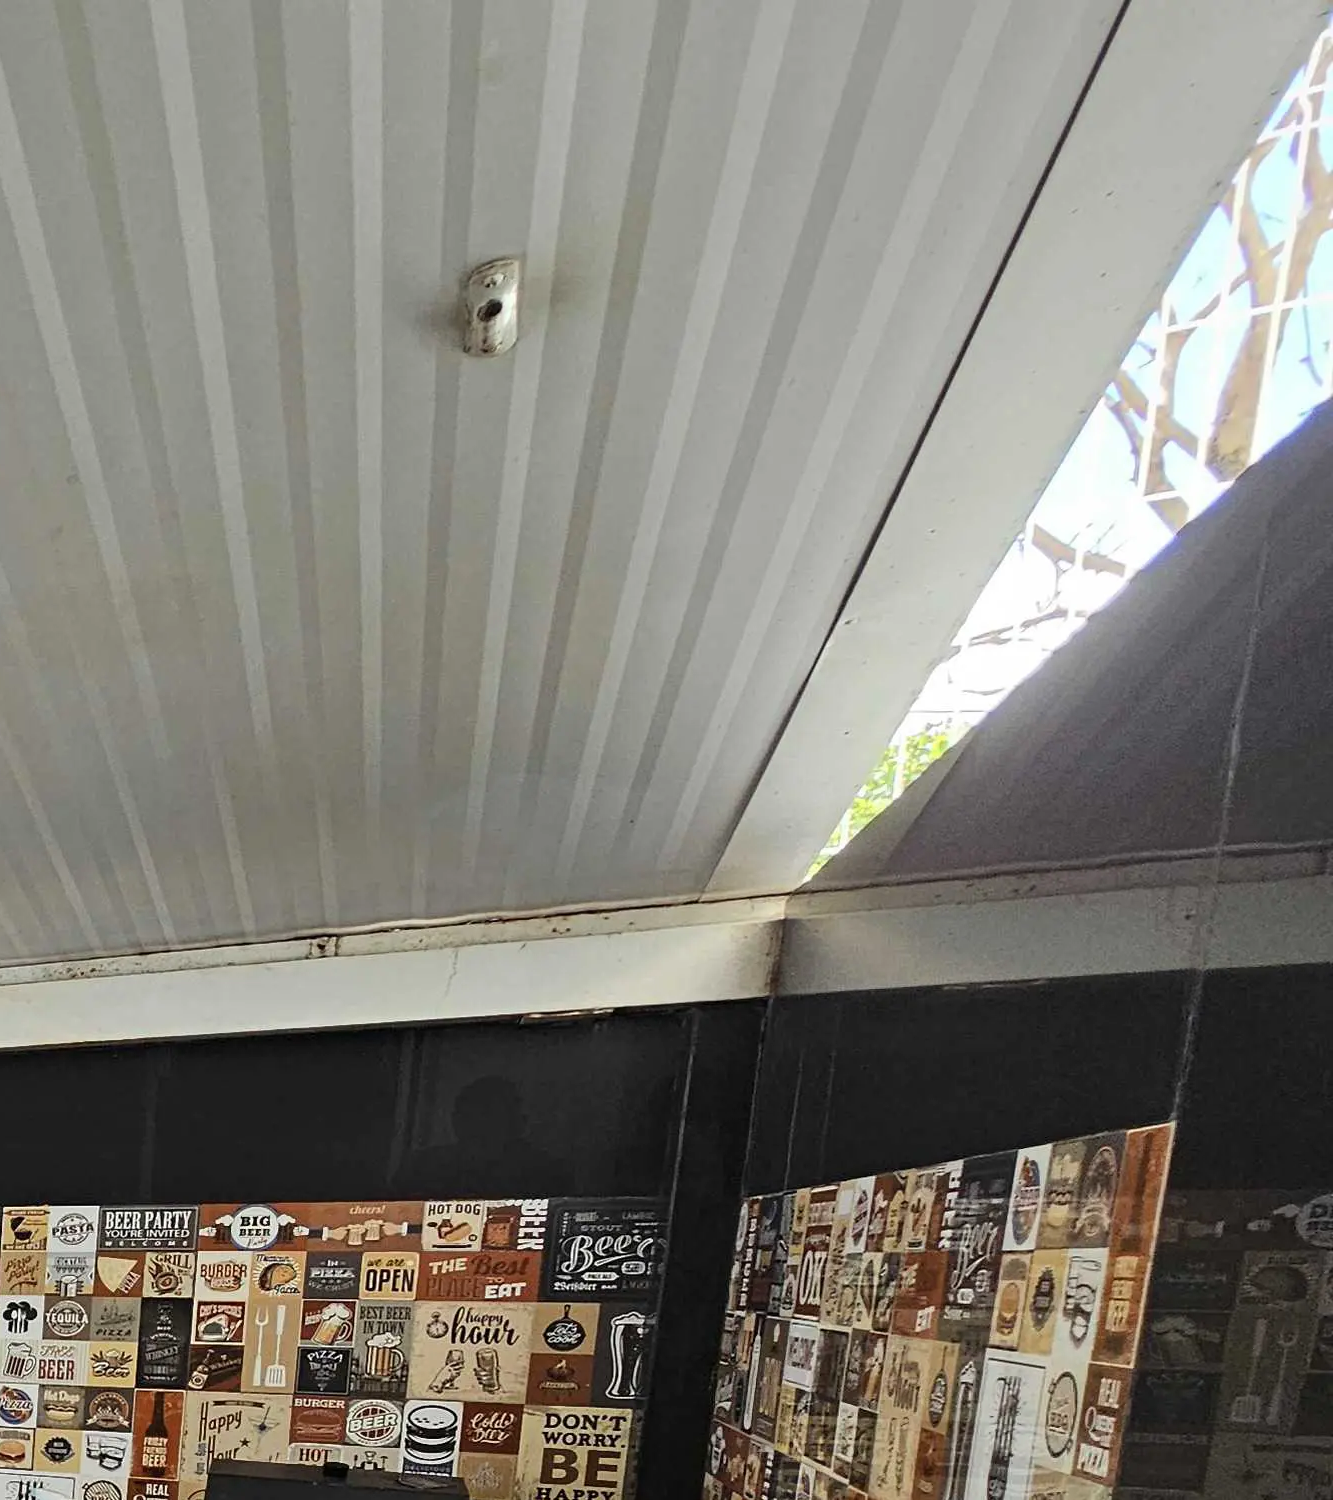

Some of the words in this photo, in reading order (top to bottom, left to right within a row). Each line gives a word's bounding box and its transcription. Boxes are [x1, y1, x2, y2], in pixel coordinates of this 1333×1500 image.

[348, 1204, 386, 1215] cheers!
[428, 1203, 454, 1217] HOT
[455, 1203, 481, 1216] DOG
[105, 1211, 143, 1230] BEER
[144, 1211, 192, 1230] PARTY
[239, 1215, 272, 1227] BIG
[52, 1222, 95, 1237] PASTA
[104, 1230, 143, 1238] YOU'RE
[145, 1230, 190, 1238] INVITED
[238, 1228, 272, 1237] BEER
[155, 1253, 192, 1270] GRILL
[560, 1235, 654, 1274] Beer
[200, 1263, 249, 1278] BURGER
[367, 1259, 382, 1267] we
[385, 1259, 406, 1267] are
[429, 1257, 469, 1276] THE
[470, 1254, 529, 1276] Best
[309, 1268, 355, 1278] PIZZA
[365, 1268, 415, 1293] OPEN
[120, 1271, 141, 1294] PIZZA
[426, 1276, 484, 1299] PLACE
[484, 1282, 527, 1299] EAT
[44, 1311, 89, 1325] TEQUILA
[359, 1306, 384, 1320] BEST
[387, 1306, 411, 1320] BEER
[465, 1306, 506, 1329] happy
[95, 1328, 132, 1337] PIZZA
[363, 1321, 374, 1334] IN
[377, 1321, 406, 1334] TOWN
[450, 1306, 520, 1346] hour
[307, 1350, 344, 1362] PIZZA
[37, 1359, 76, 1382] BEER
[93, 1361, 131, 1379] Beer
[44, 1389, 58, 1401] Hot
[59, 1390, 81, 1403] Dogs
[294, 1398, 346, 1409] BURGER
[198, 1400, 243, 1443] Happy
[347, 1414, 398, 1433] BEER
[469, 1412, 515, 1430] Cold
[544, 1412, 627, 1431] DON'T
[542, 1432, 626, 1449] WORRY.
[142, 1453, 167, 1468] BEER
[298, 1448, 333, 1463] HOT
[539, 1447, 626, 1489] BE
[145, 1483, 169, 1496] REAL
